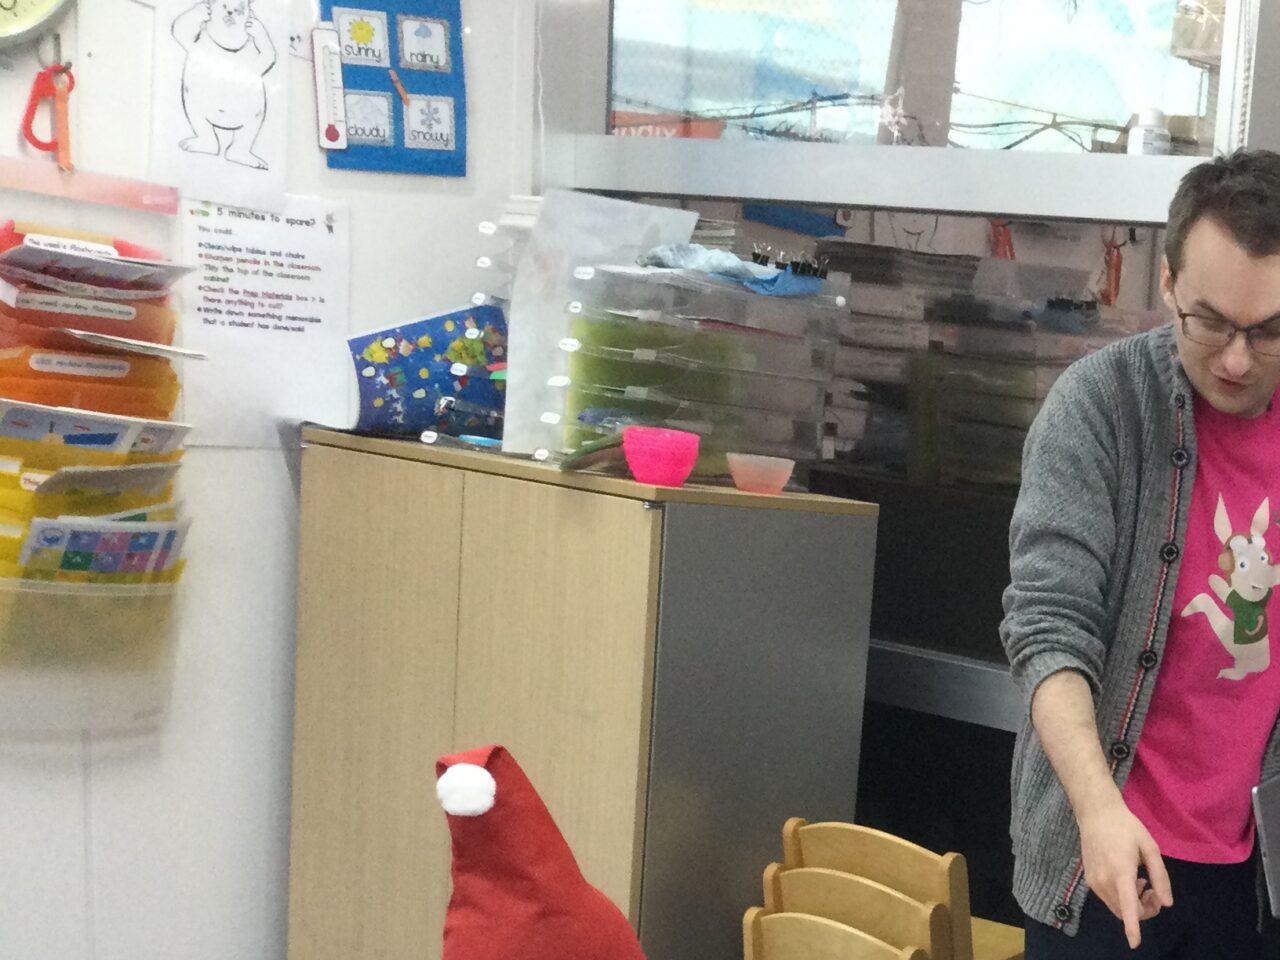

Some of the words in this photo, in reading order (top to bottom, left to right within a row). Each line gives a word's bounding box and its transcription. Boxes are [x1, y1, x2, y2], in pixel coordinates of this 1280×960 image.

[344, 45, 382, 63] sunny
[410, 52, 440, 67] rainy
[347, 123, 386, 142] cloudy
[410, 129, 449, 147] snowy
[217, 207, 223, 216] 5
[228, 209, 266, 221] minutes
[270, 214, 280, 223] to
[285, 217, 316, 228] spare?
